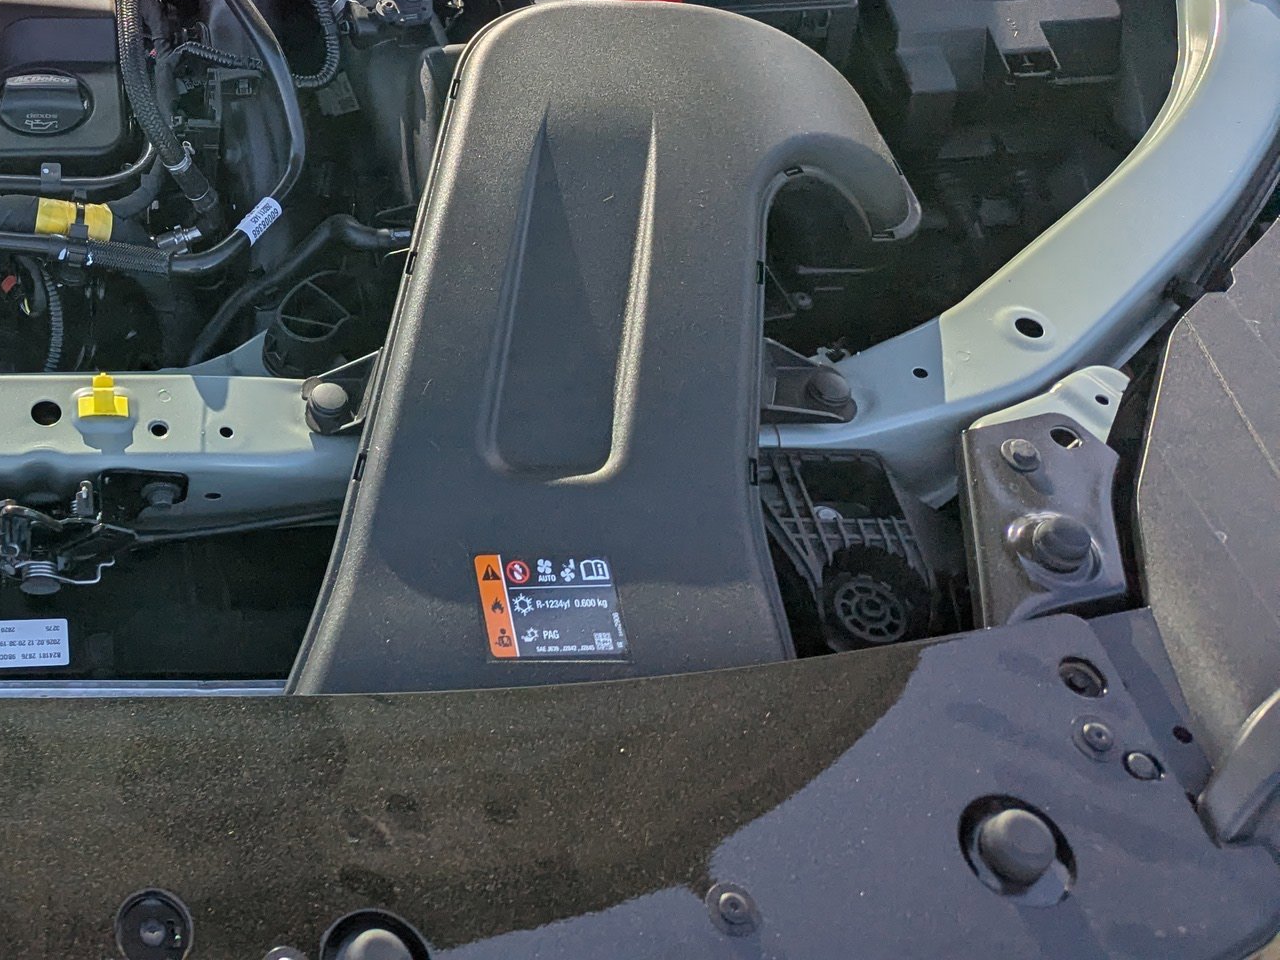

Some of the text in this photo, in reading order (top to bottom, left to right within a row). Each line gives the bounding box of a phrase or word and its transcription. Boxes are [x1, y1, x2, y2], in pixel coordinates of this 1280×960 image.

[538, 574, 557, 583] AUTO
[574, 598, 596, 608] 0.600
[597, 596, 608, 609] kg
[542, 630, 560, 640] PAG
